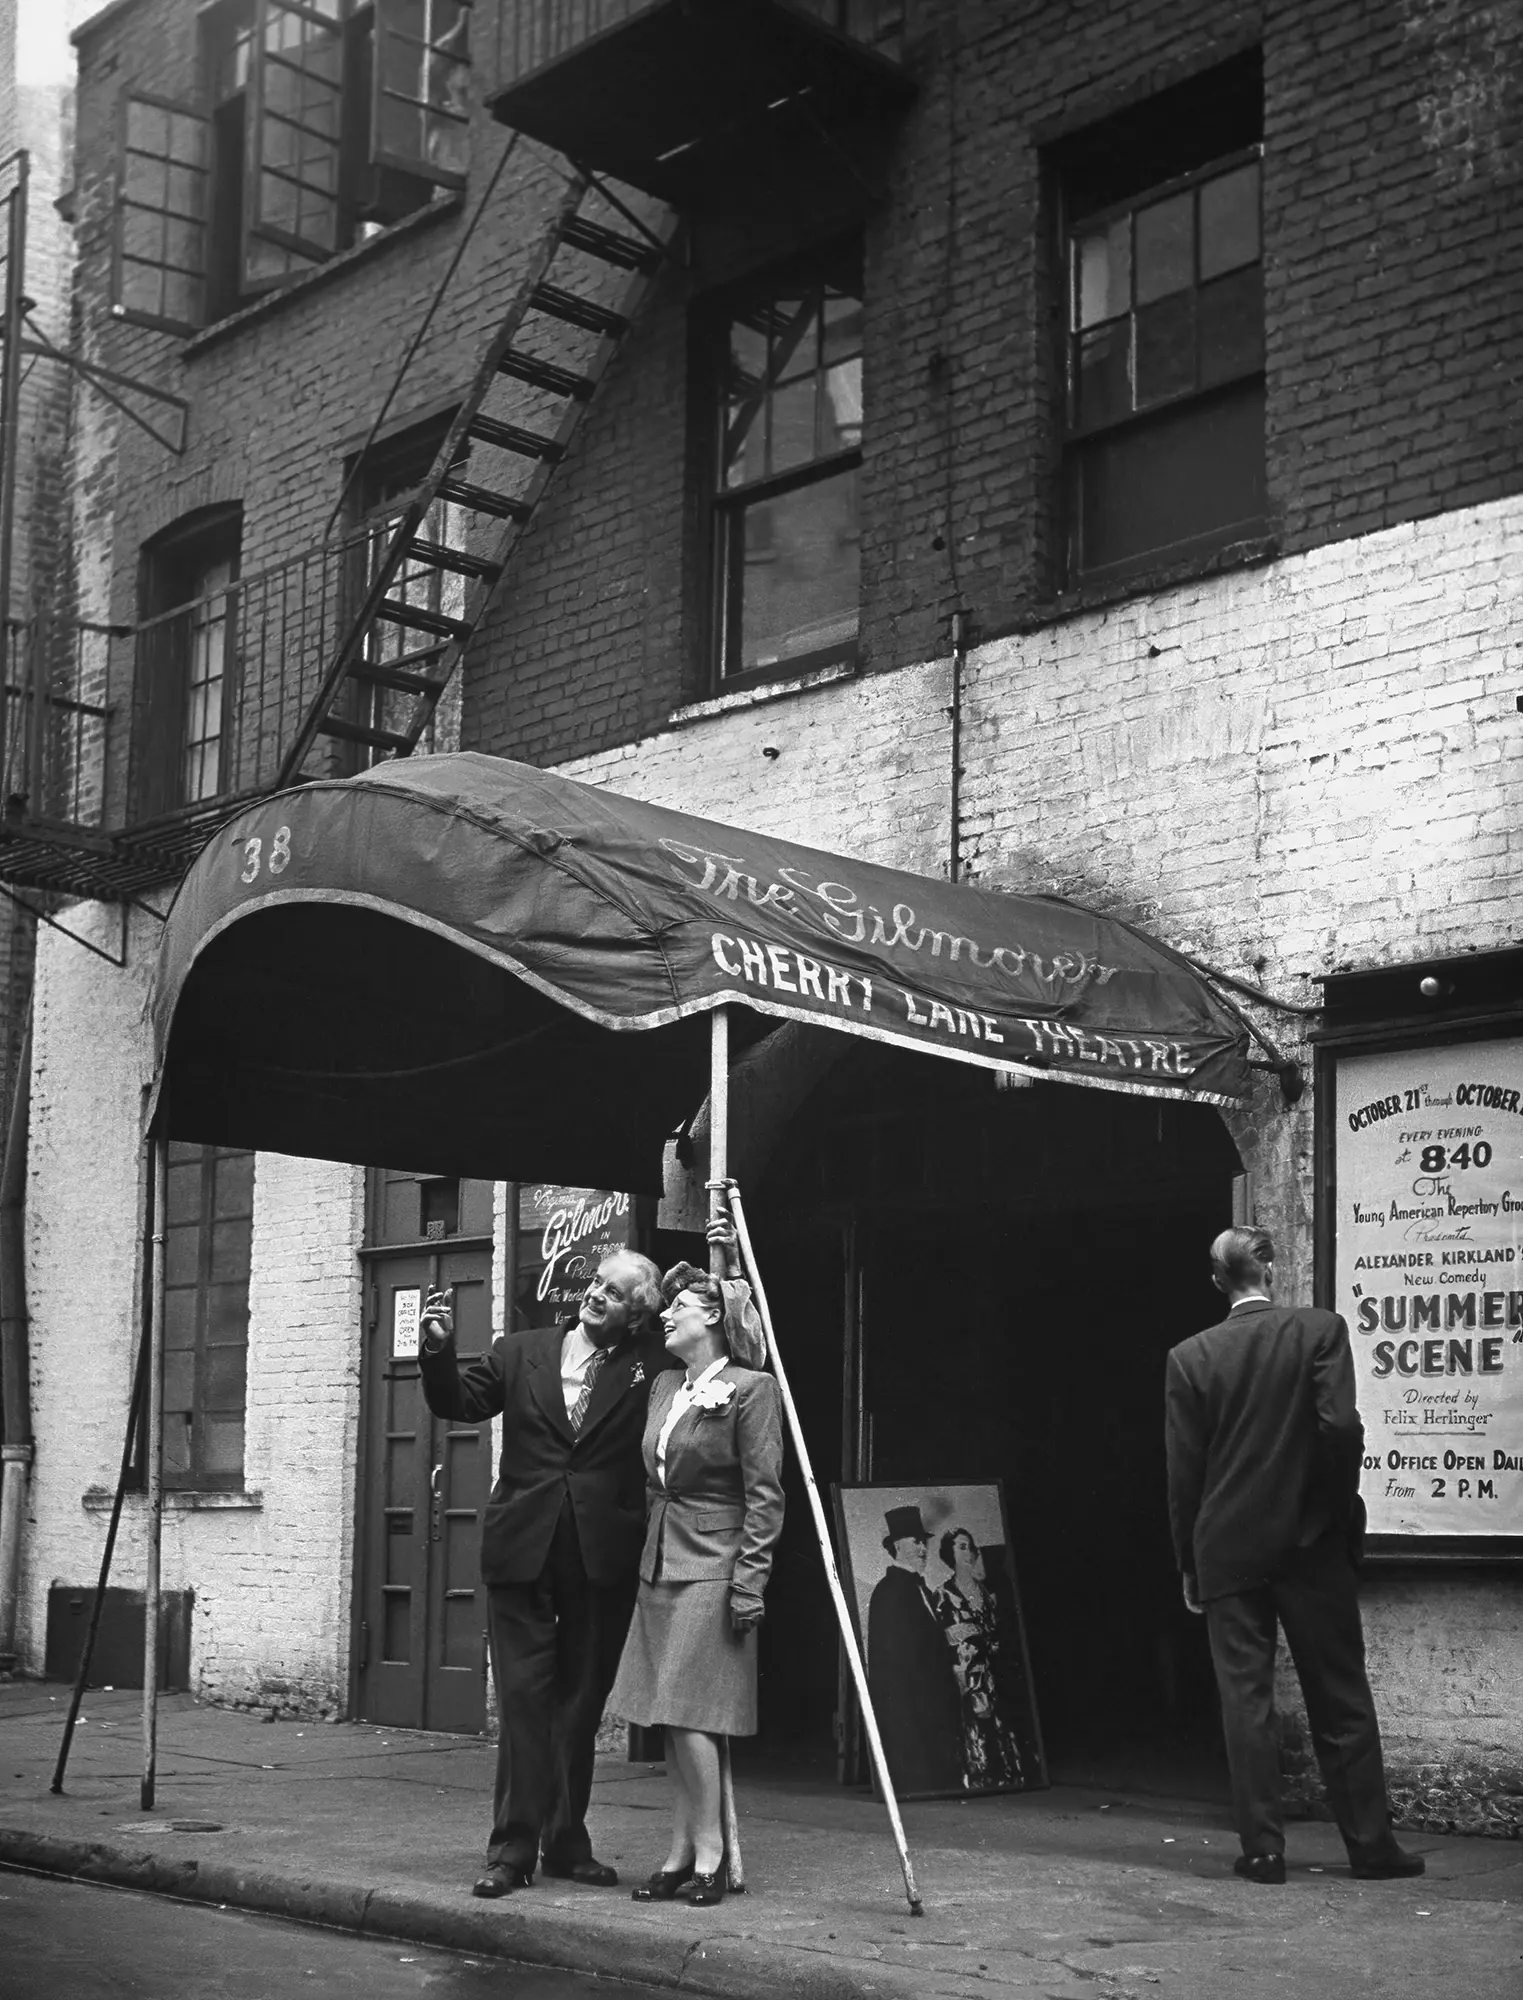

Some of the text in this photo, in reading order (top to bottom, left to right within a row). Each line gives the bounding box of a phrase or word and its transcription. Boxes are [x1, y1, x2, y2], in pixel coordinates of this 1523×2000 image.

[241, 825, 291, 883] 38
[659, 838, 799, 914] The
[711, 933, 1197, 1075] CHERRY LANE THEATRE
[1348, 1095, 1403, 1132] OCTOBER
[1456, 1083, 1520, 1113] OCTOBER
[1399, 1125, 1483, 1143] EVERY EVENING
[1395, 1141, 1492, 1173] at 8:40
[1413, 1176, 1451, 1196] The
[1353, 1203, 1385, 1227] Young
[1389, 1200, 1444, 1221] American
[1448, 1193, 1499, 1219] Repertory
[600, 1231, 611, 1240] IN
[1354, 1252, 1434, 1270] ALEXANDER
[1404, 1268, 1486, 1290] New Comedy
[1402, 1388, 1479, 1410] Directed by
[1382, 1408, 1493, 1431] Felix Herlinger
[1363, 1455, 1382, 1470] OX
[1387, 1449, 1438, 1470] OFFICE
[1443, 1449, 1486, 1470] OPEN
[1384, 1478, 1416, 1498] From
[1431, 1478, 1446, 1498] 2
